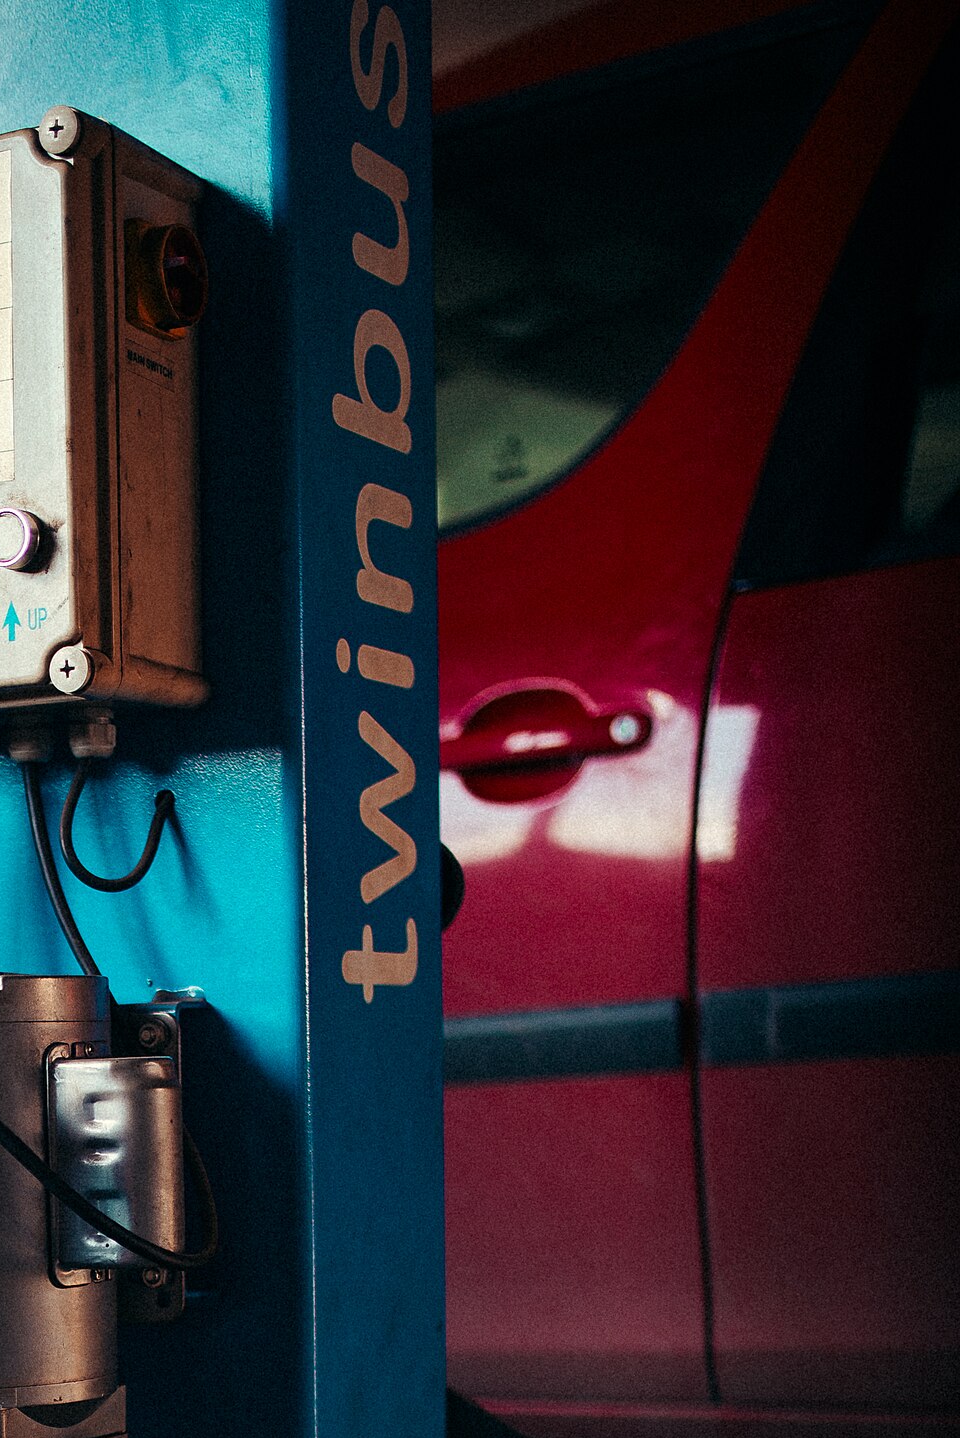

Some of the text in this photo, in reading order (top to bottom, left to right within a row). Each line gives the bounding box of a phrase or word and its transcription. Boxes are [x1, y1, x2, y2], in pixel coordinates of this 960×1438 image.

[127, 350, 173, 379] MAIN SWITCH
[333, 0, 419, 1004] twinbus
[28, 607, 48, 631] UP
